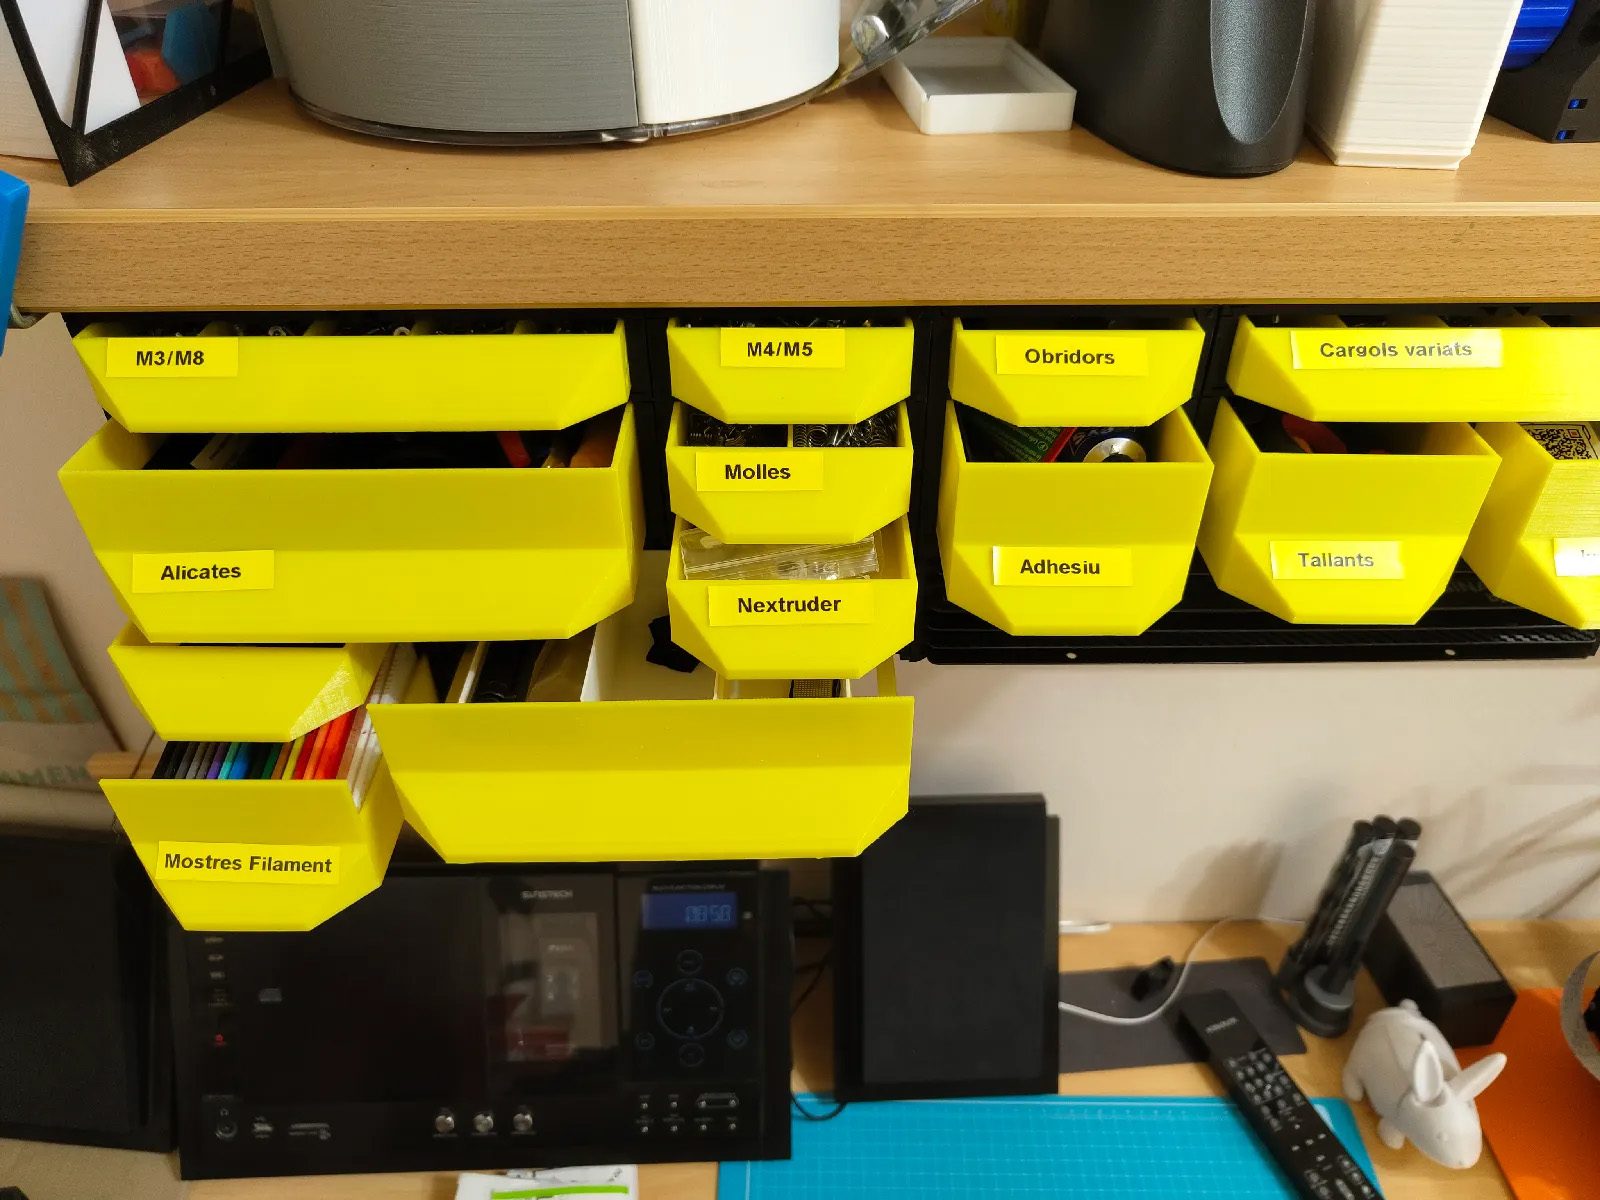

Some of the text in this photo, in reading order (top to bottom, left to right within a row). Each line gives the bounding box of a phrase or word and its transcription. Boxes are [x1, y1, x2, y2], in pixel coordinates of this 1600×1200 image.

[136, 350, 205, 367] M3/M8
[746, 341, 813, 358] M4/M5
[1024, 348, 1116, 365] Obridors
[1319, 341, 1473, 359] Cargols variats
[724, 463, 792, 480] Molles
[1019, 558, 1101, 576] Adhesiu
[1297, 551, 1375, 569] Tallants
[160, 563, 242, 581] Alicates
[737, 595, 842, 614] Nextruder
[164, 853, 334, 874] Mostres Filament
